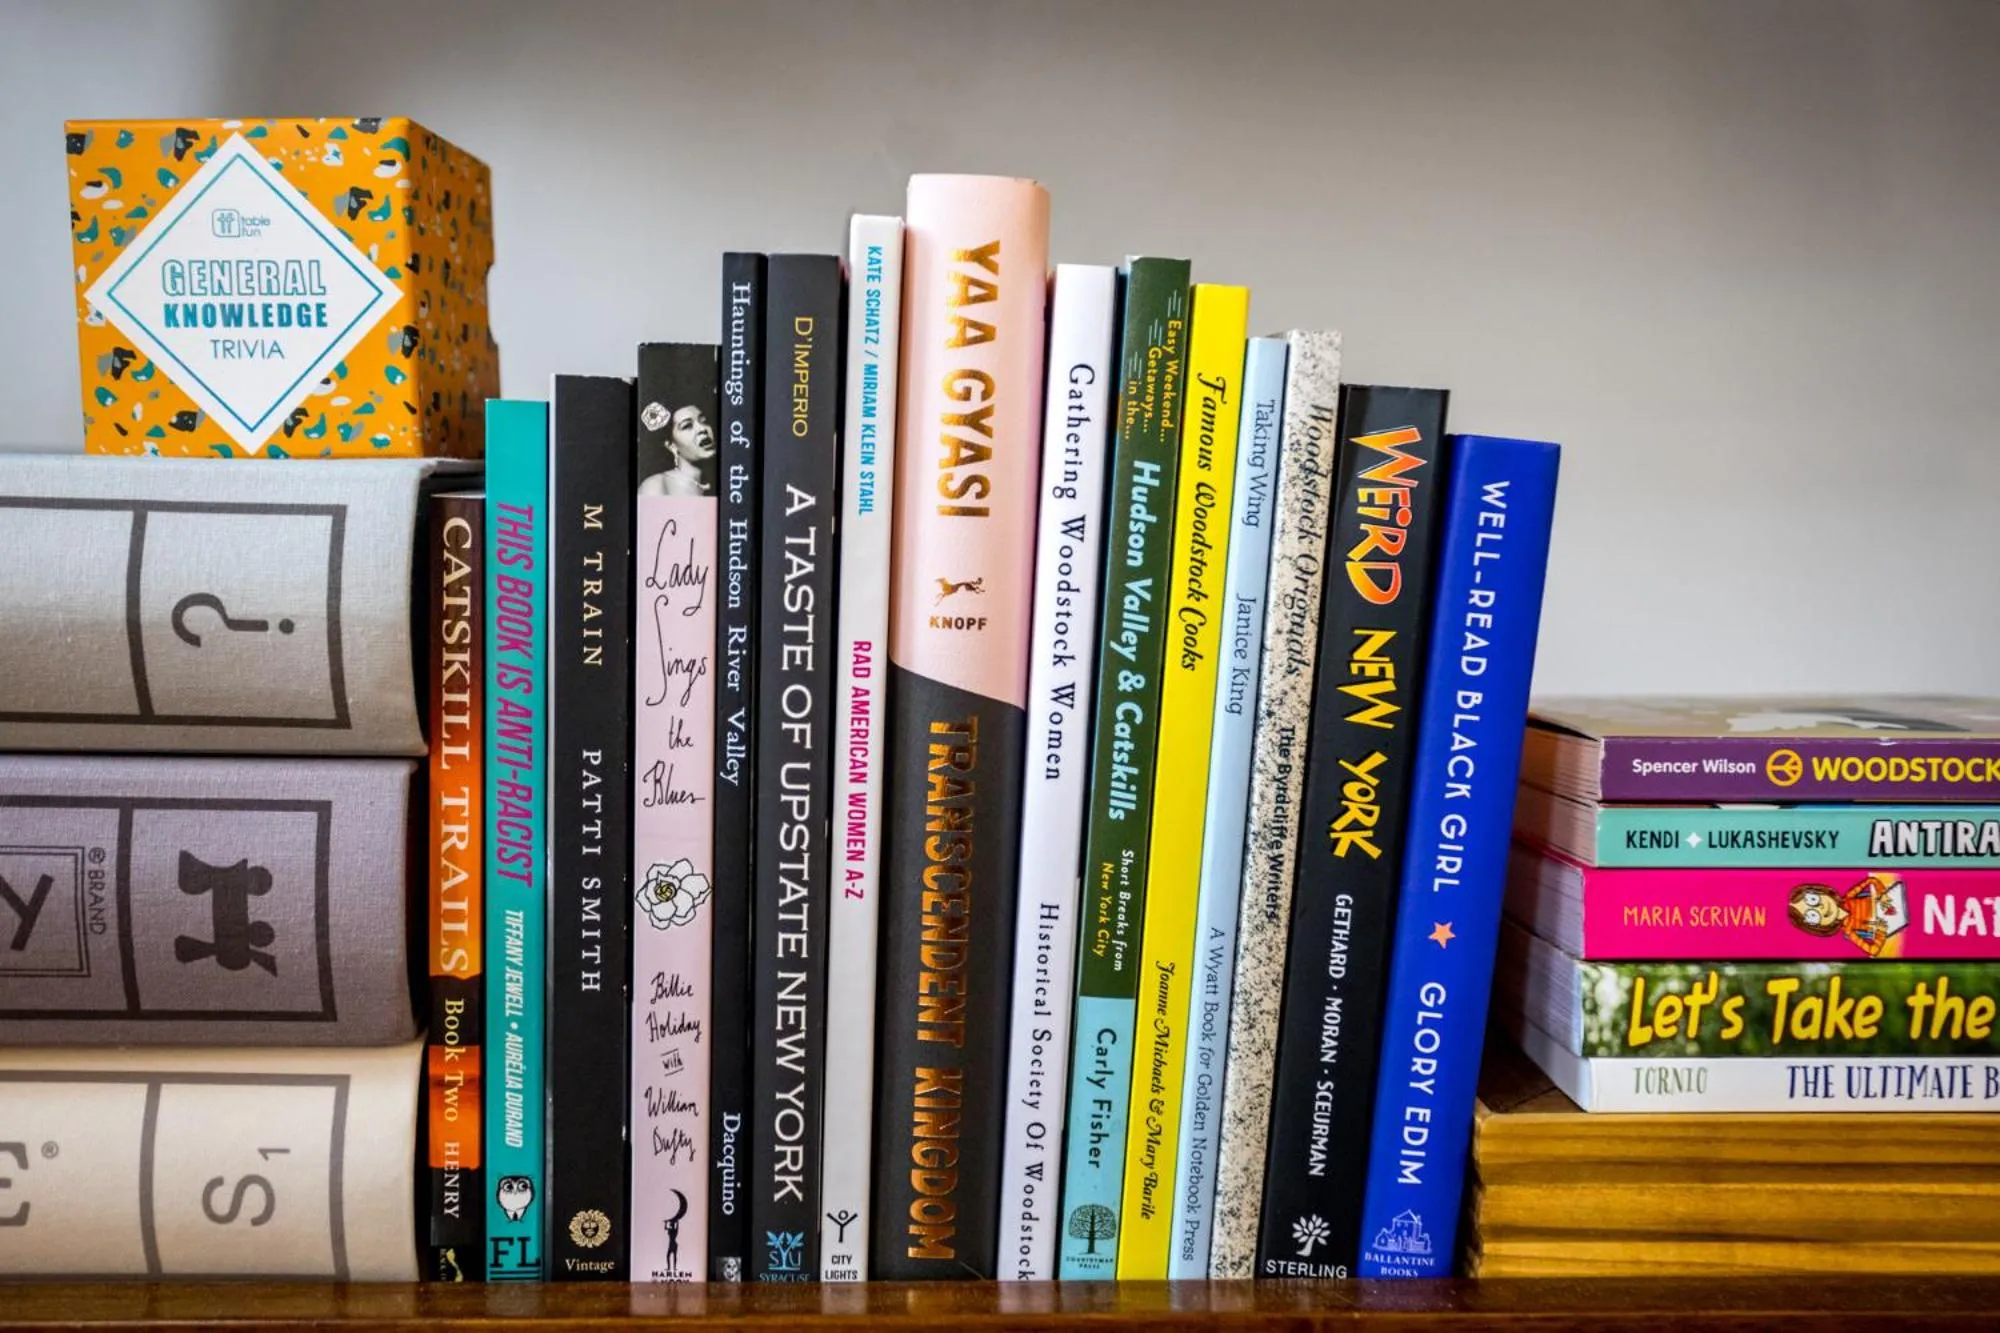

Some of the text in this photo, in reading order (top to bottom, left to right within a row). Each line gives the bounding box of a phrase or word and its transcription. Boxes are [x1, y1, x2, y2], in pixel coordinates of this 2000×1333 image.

[162, 259, 327, 297] GENERAL
[866, 246, 882, 283] KATE
[163, 302, 328, 328] KNOWLEDGE
[210, 339, 285, 360] TRIVIA
[864, 289, 881, 352] SCHATZ
[1162, 319, 1183, 354] Easy
[792, 316, 813, 437] D'IMPERIO
[860, 363, 878, 425] MIRIAM
[936, 239, 1001, 518] YAA GYASI
[1127, 380, 1142, 395] in
[859, 424, 877, 466] KLEIN
[1241, 399, 1275, 529] Taking Wing
[858, 471, 874, 516] STAHL
[1178, 372, 1227, 672] Famous Woodstock Cooks
[645, 519, 709, 616] Lady
[720, 282, 750, 787] Hauntings of the Hudson River Valley
[583, 503, 604, 666] M TRAIN
[1045, 363, 1096, 780] Gathering Woodstock Women
[441, 517, 472, 770] CATSKILL
[645, 595, 708, 707] Sings
[929, 616, 988, 631] KNOPF
[1109, 460, 1161, 821] Hudson Valley & Catskills
[1225, 593, 1257, 717] Janice King
[496, 502, 534, 889] THIS BOOK IS ANTI-RACIST
[1336, 629, 1402, 729] NEW
[1432, 480, 1511, 892] WELL-READ BLACK GIRL
[669, 716, 694, 750] the
[1632, 758, 1756, 776] Spencer Wilson
[642, 760, 706, 808] Blues
[845, 640, 872, 900] RAD AMERICAN WOMEN A-Z
[1812, 757, 2000, 782] WOODSTOCK
[1264, 726, 1296, 922] The Byrdcliffe Writers
[1331, 751, 1389, 861] YORK
[1625, 830, 1839, 849] KENDI LUKASHEVSKY
[581, 750, 602, 991] PATTI SMITH
[774, 483, 816, 1203] A TASTE OF UPSTATE NEW YORK
[88, 870, 107, 935] BRAND
[440, 787, 470, 973] TRAILS
[1091, 862, 1115, 957] New York City
[1111, 849, 1135, 972] Short Breaks from
[1623, 906, 1766, 928] MARIA SCRIVAN
[651, 971, 694, 1004] Billie
[907, 714, 978, 1259] TRANSCENDENT KINGDOM
[1155, 960, 1176, 1016] Joanne
[1628, 970, 1997, 1048] Let's Take the
[504, 909, 527, 1148] TIFFANY JEWELL AURÉLIA DURAND
[645, 1012, 702, 1043] Holiday
[662, 1053, 684, 1071] with
[1150, 1019, 1171, 1095] Michaels
[1308, 893, 1354, 1176] GETHARD MORAN SCEURMAN
[644, 1086, 699, 1117] William
[1018, 903, 1060, 1280] Historical Society Of Woodstock
[1085, 1028, 1118, 1169] Carly Fisher
[1182, 927, 1225, 1261] A Wyatt Book for Golden Notebook Press
[1396, 982, 1447, 1185] GLORY EDIM
[1787, 1064, 1836, 1099] THE
[1845, 1064, 1974, 1100] ULTIMATE
[653, 1126, 697, 1165] Dufty
[716, 1112, 741, 1215] Dacquino
[1140, 1115, 1163, 1170] Mary
[443, 1140, 460, 1219] HENRY
[1140, 1169, 1159, 1221] Barile
[490, 1237, 541, 1268] FL
[565, 1258, 615, 1274] Vintage
[825, 1269, 858, 1280] LIGHTS
[831, 1255, 853, 1266] CITY
[1266, 1260, 1347, 1279] STERLING
[1365, 1252, 1436, 1267] BALLANTINE
[1380, 1266, 1419, 1278] BOOKS
